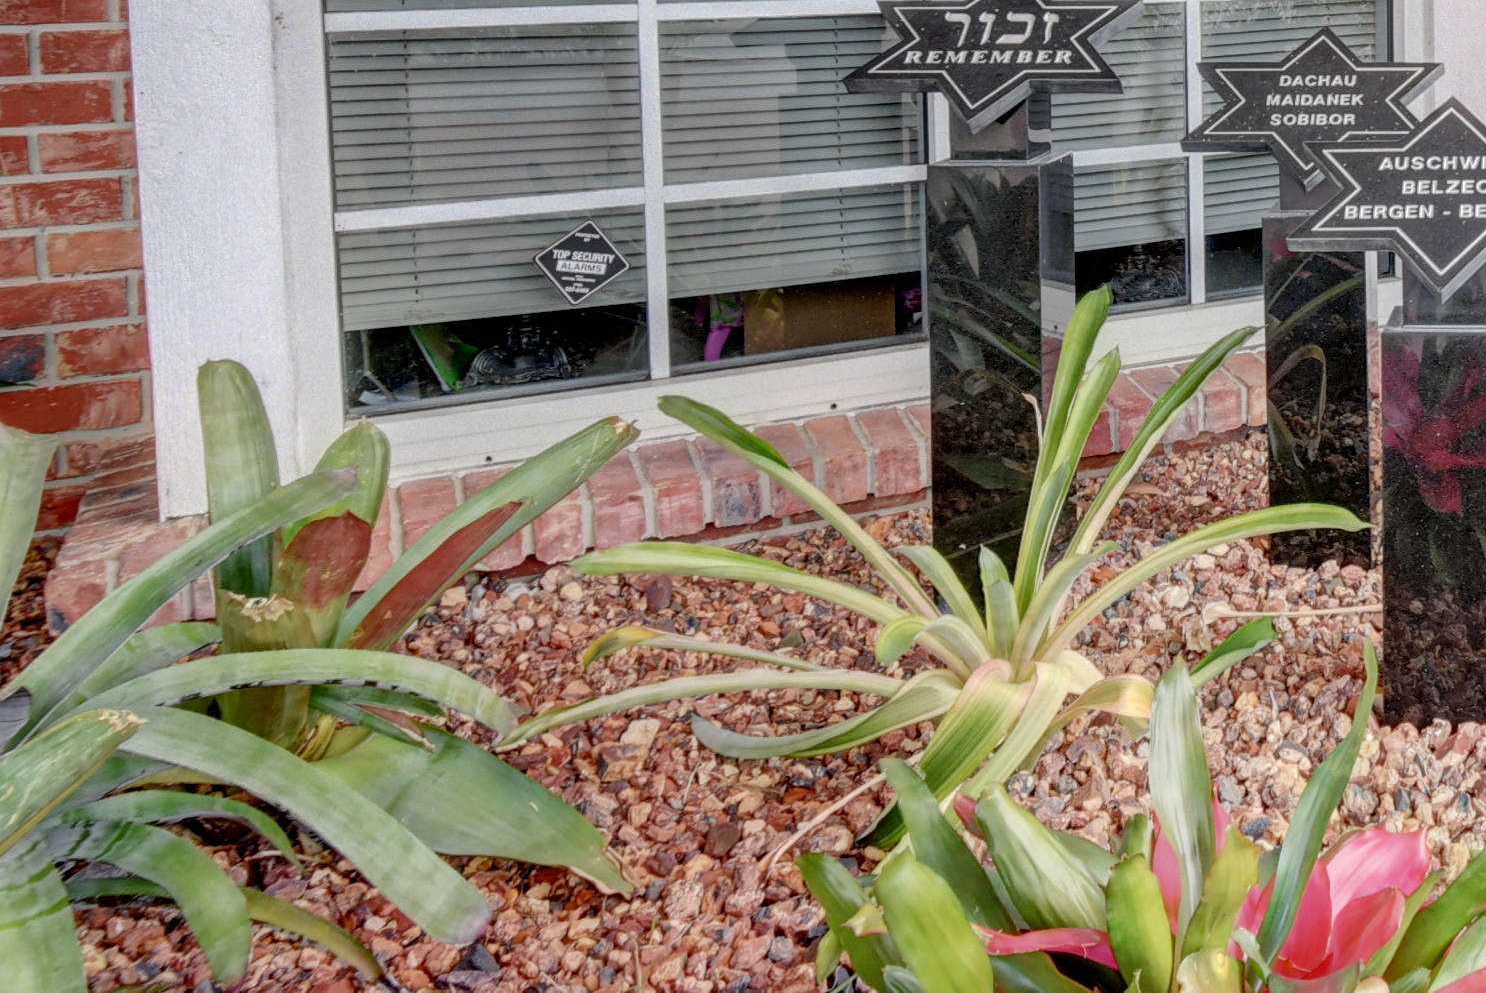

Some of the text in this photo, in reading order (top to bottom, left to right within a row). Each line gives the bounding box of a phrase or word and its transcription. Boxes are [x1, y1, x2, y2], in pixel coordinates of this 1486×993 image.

[944, 10, 1060, 48] זכור
[903, 50, 1072, 65] REMEMBER
[1279, 74, 1357, 87] DACHAU
[1265, 94, 1364, 106] MAIDANEK
[1269, 113, 1356, 126] SOBIBOR
[1343, 204, 1435, 220] BERGEN
[552, 249, 615, 264] TOP SECURITY
[561, 262, 603, 273] ALARMS
